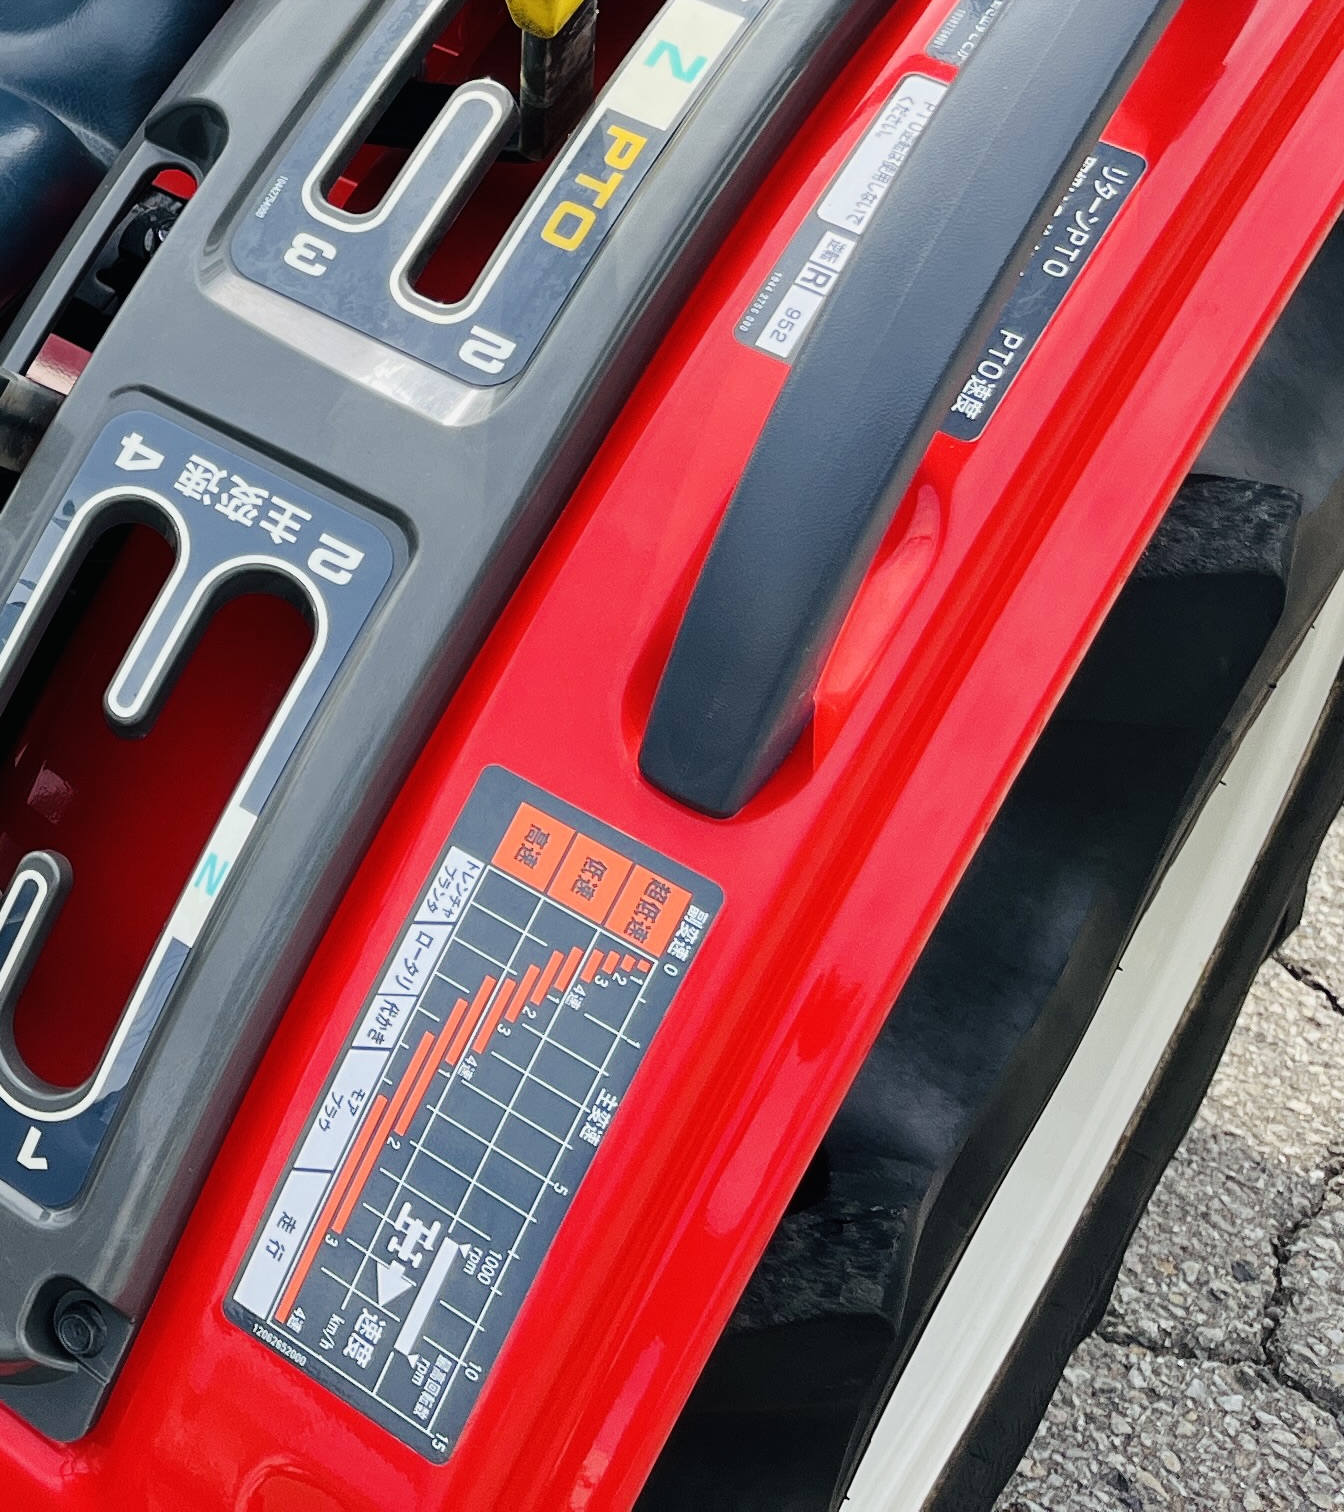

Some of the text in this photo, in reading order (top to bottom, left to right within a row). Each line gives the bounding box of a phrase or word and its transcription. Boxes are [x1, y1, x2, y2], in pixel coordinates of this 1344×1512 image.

[643, 39, 708, 84] N
[541, 123, 649, 252] PTO
[1041, 165, 1130, 279] リターンPTO
[282, 231, 338, 278] 3
[818, 237, 848, 265] 逆転
[799, 263, 834, 288] R
[768, 305, 803, 345] 952
[458, 325, 517, 376] 2
[950, 327, 1025, 421] PTO速度
[115, 431, 165, 474] 4
[173, 452, 313, 548] 主変速
[308, 531, 367, 587] 2
[513, 823, 551, 870] 高速
[194, 852, 230, 897] N
[436, 860, 481, 924] トレンチャ
[569, 855, 608, 902] 低速
[623, 877, 672, 945] 超低速
[666, 904, 710, 962] 副変速
[395, 930, 434, 991] ロータリ
[663, 963, 679, 977] 0
[366, 998, 401, 1050] 代かき
[347, 1088, 366, 1117] モア
[578, 1087, 619, 1147] 主変速
[16, 1125, 51, 1172] 1
[551, 1182, 569, 1197] 5
[265, 1211, 297, 1262] 走行
[462, 1245, 484, 1276] rpm
[476, 1249, 503, 1285] 1000
[318, 1313, 346, 1350] km/h
[342, 1307, 387, 1369] 速度
[411, 1357, 431, 1387] rpm
[412, 1353, 453, 1421] 最高回転数
[464, 1361, 483, 1381] 10
[431, 1432, 449, 1453] 15
